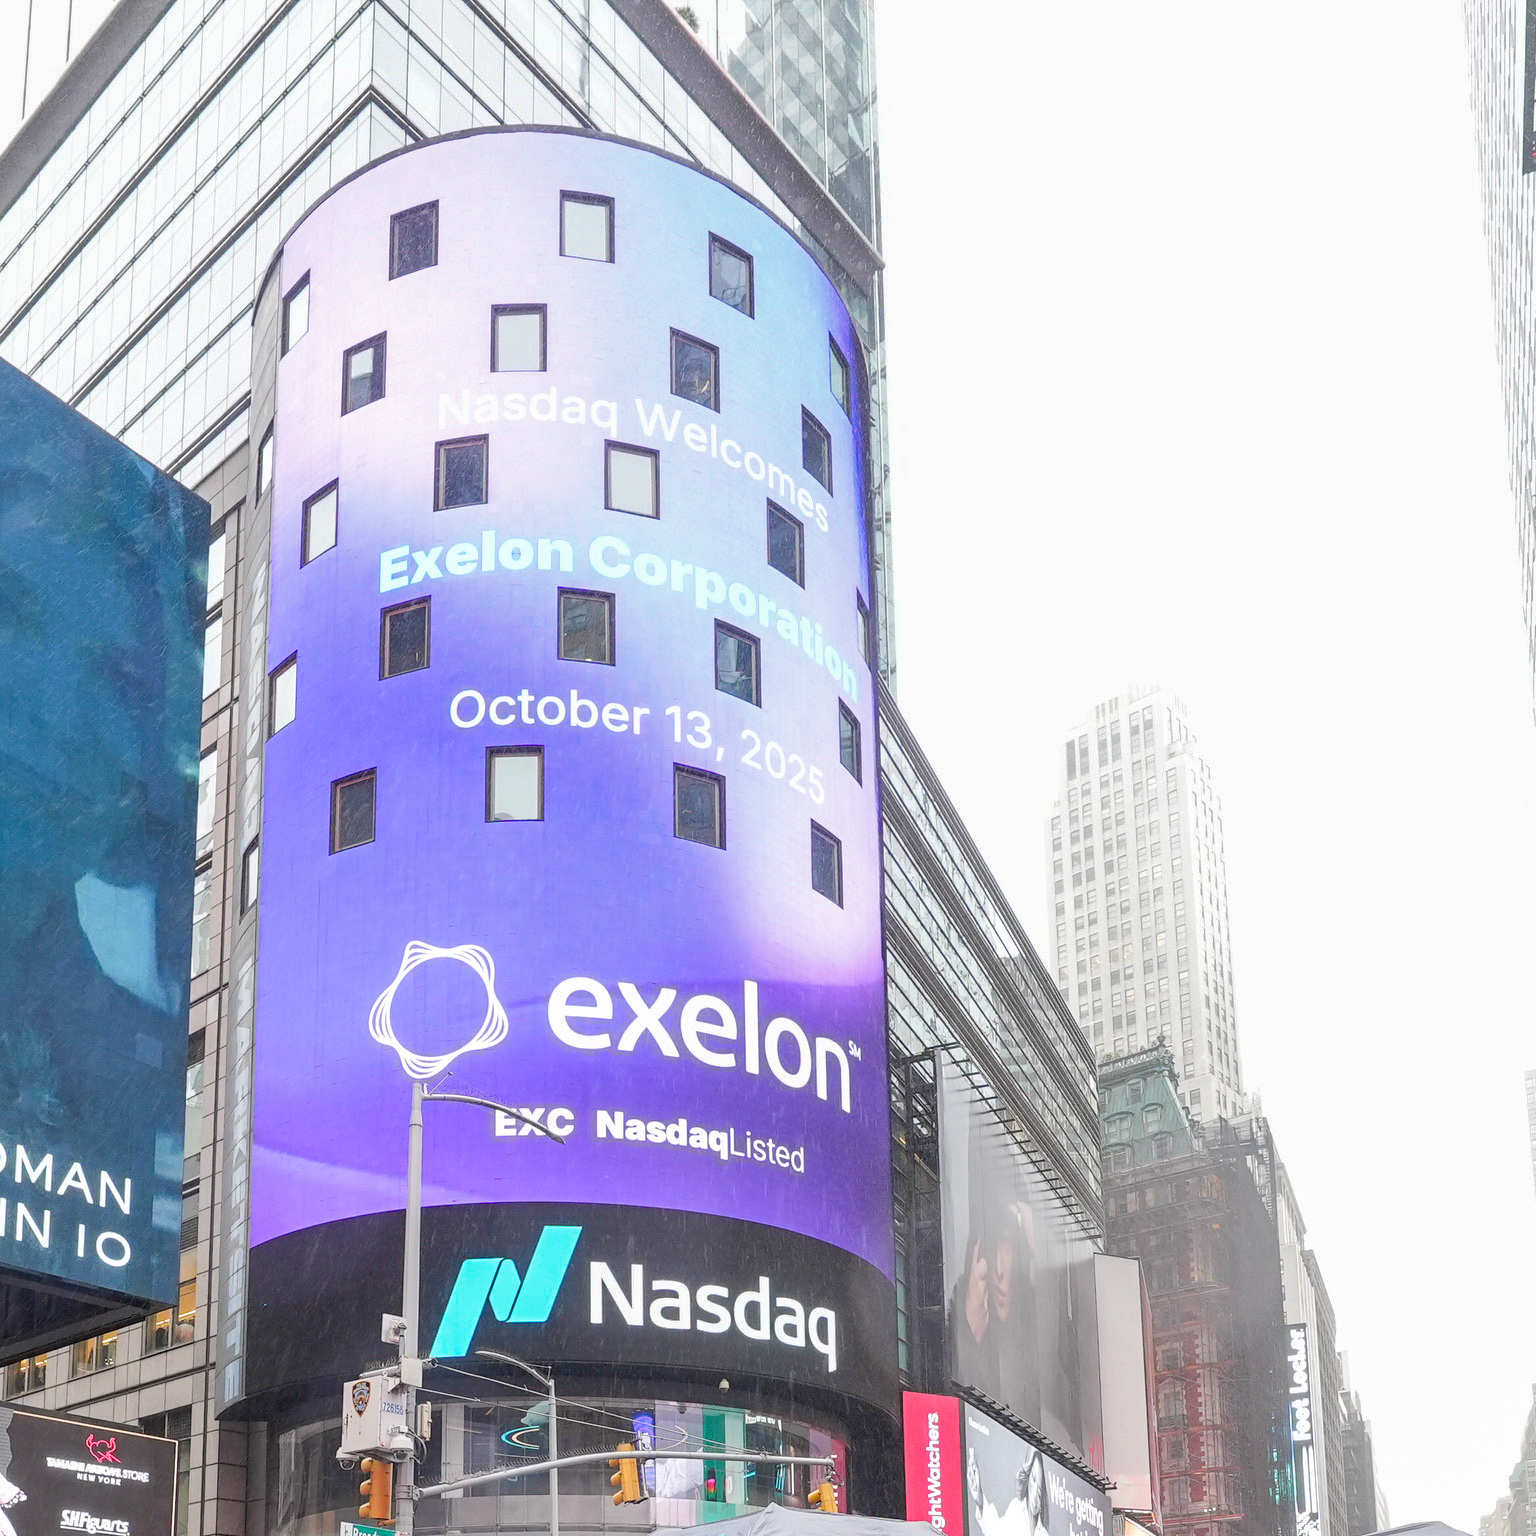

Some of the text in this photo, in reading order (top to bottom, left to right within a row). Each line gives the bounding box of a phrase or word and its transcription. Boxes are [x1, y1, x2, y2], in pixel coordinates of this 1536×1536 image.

[438, 384, 829, 534] Nasdaq Welcomes
[379, 530, 859, 703] Exelon Corporation
[449, 689, 825, 805] October 13, 2025
[548, 976, 852, 1114] exelon
[495, 1108, 575, 1137] EXC
[589, 1261, 838, 1372] Nasdaq
[77, 1474, 122, 1486] NEW YORK
[926, 1412, 945, 1532] ghtWatchers
[1048, 1471, 1104, 1536] We're getting
